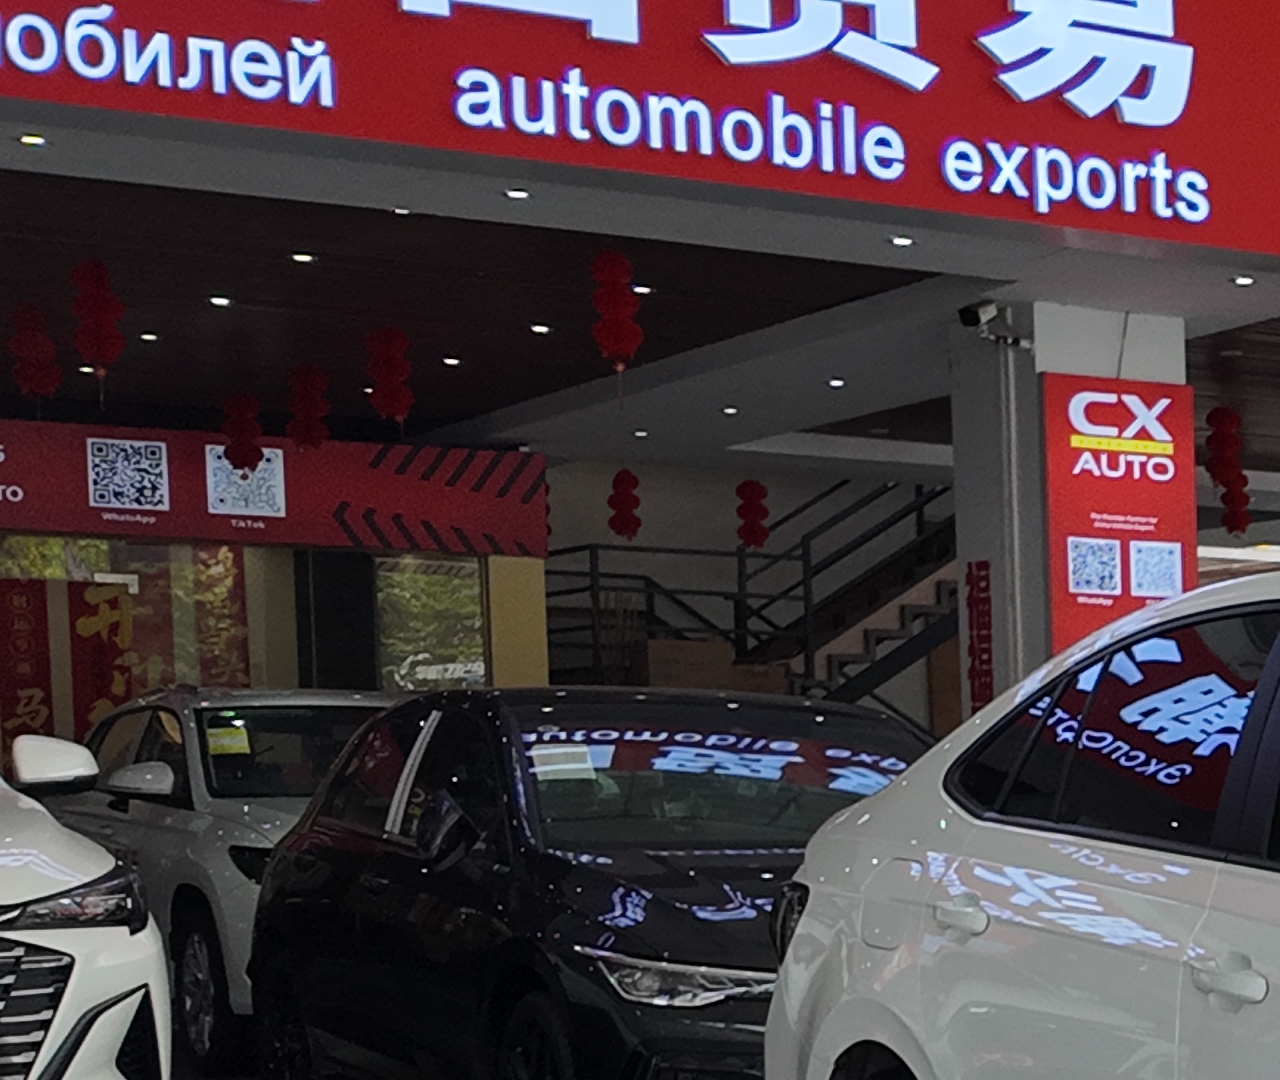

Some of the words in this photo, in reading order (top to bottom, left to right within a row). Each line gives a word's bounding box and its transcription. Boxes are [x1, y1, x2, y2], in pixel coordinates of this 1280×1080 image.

[0, 5, 335, 108] обилей
[454, 64, 906, 182] automobile
[939, 135, 1212, 223] exports
[1068, 391, 1173, 442] CX
[1072, 451, 1175, 481] AUTO
[102, 511, 156, 524] WhatsApp
